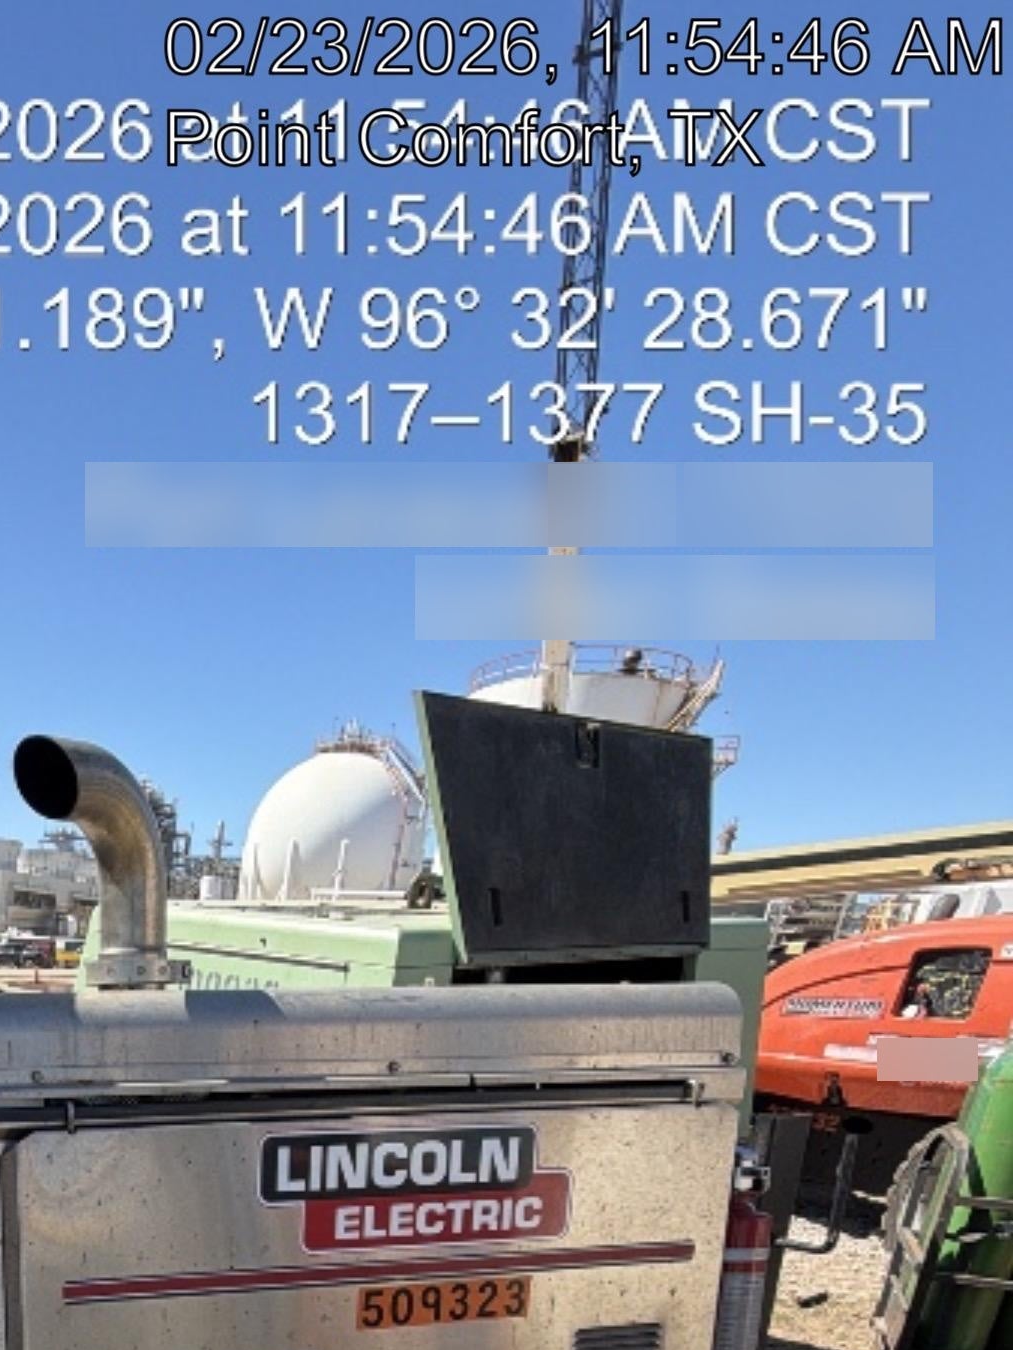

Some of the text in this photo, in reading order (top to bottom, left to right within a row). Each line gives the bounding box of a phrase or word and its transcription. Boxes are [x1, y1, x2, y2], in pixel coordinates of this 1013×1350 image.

[275, 1135, 521, 1193] LINCOLN
[334, 1196, 544, 1241] ELECTRIC
[360, 1278, 526, 1329] 509323
